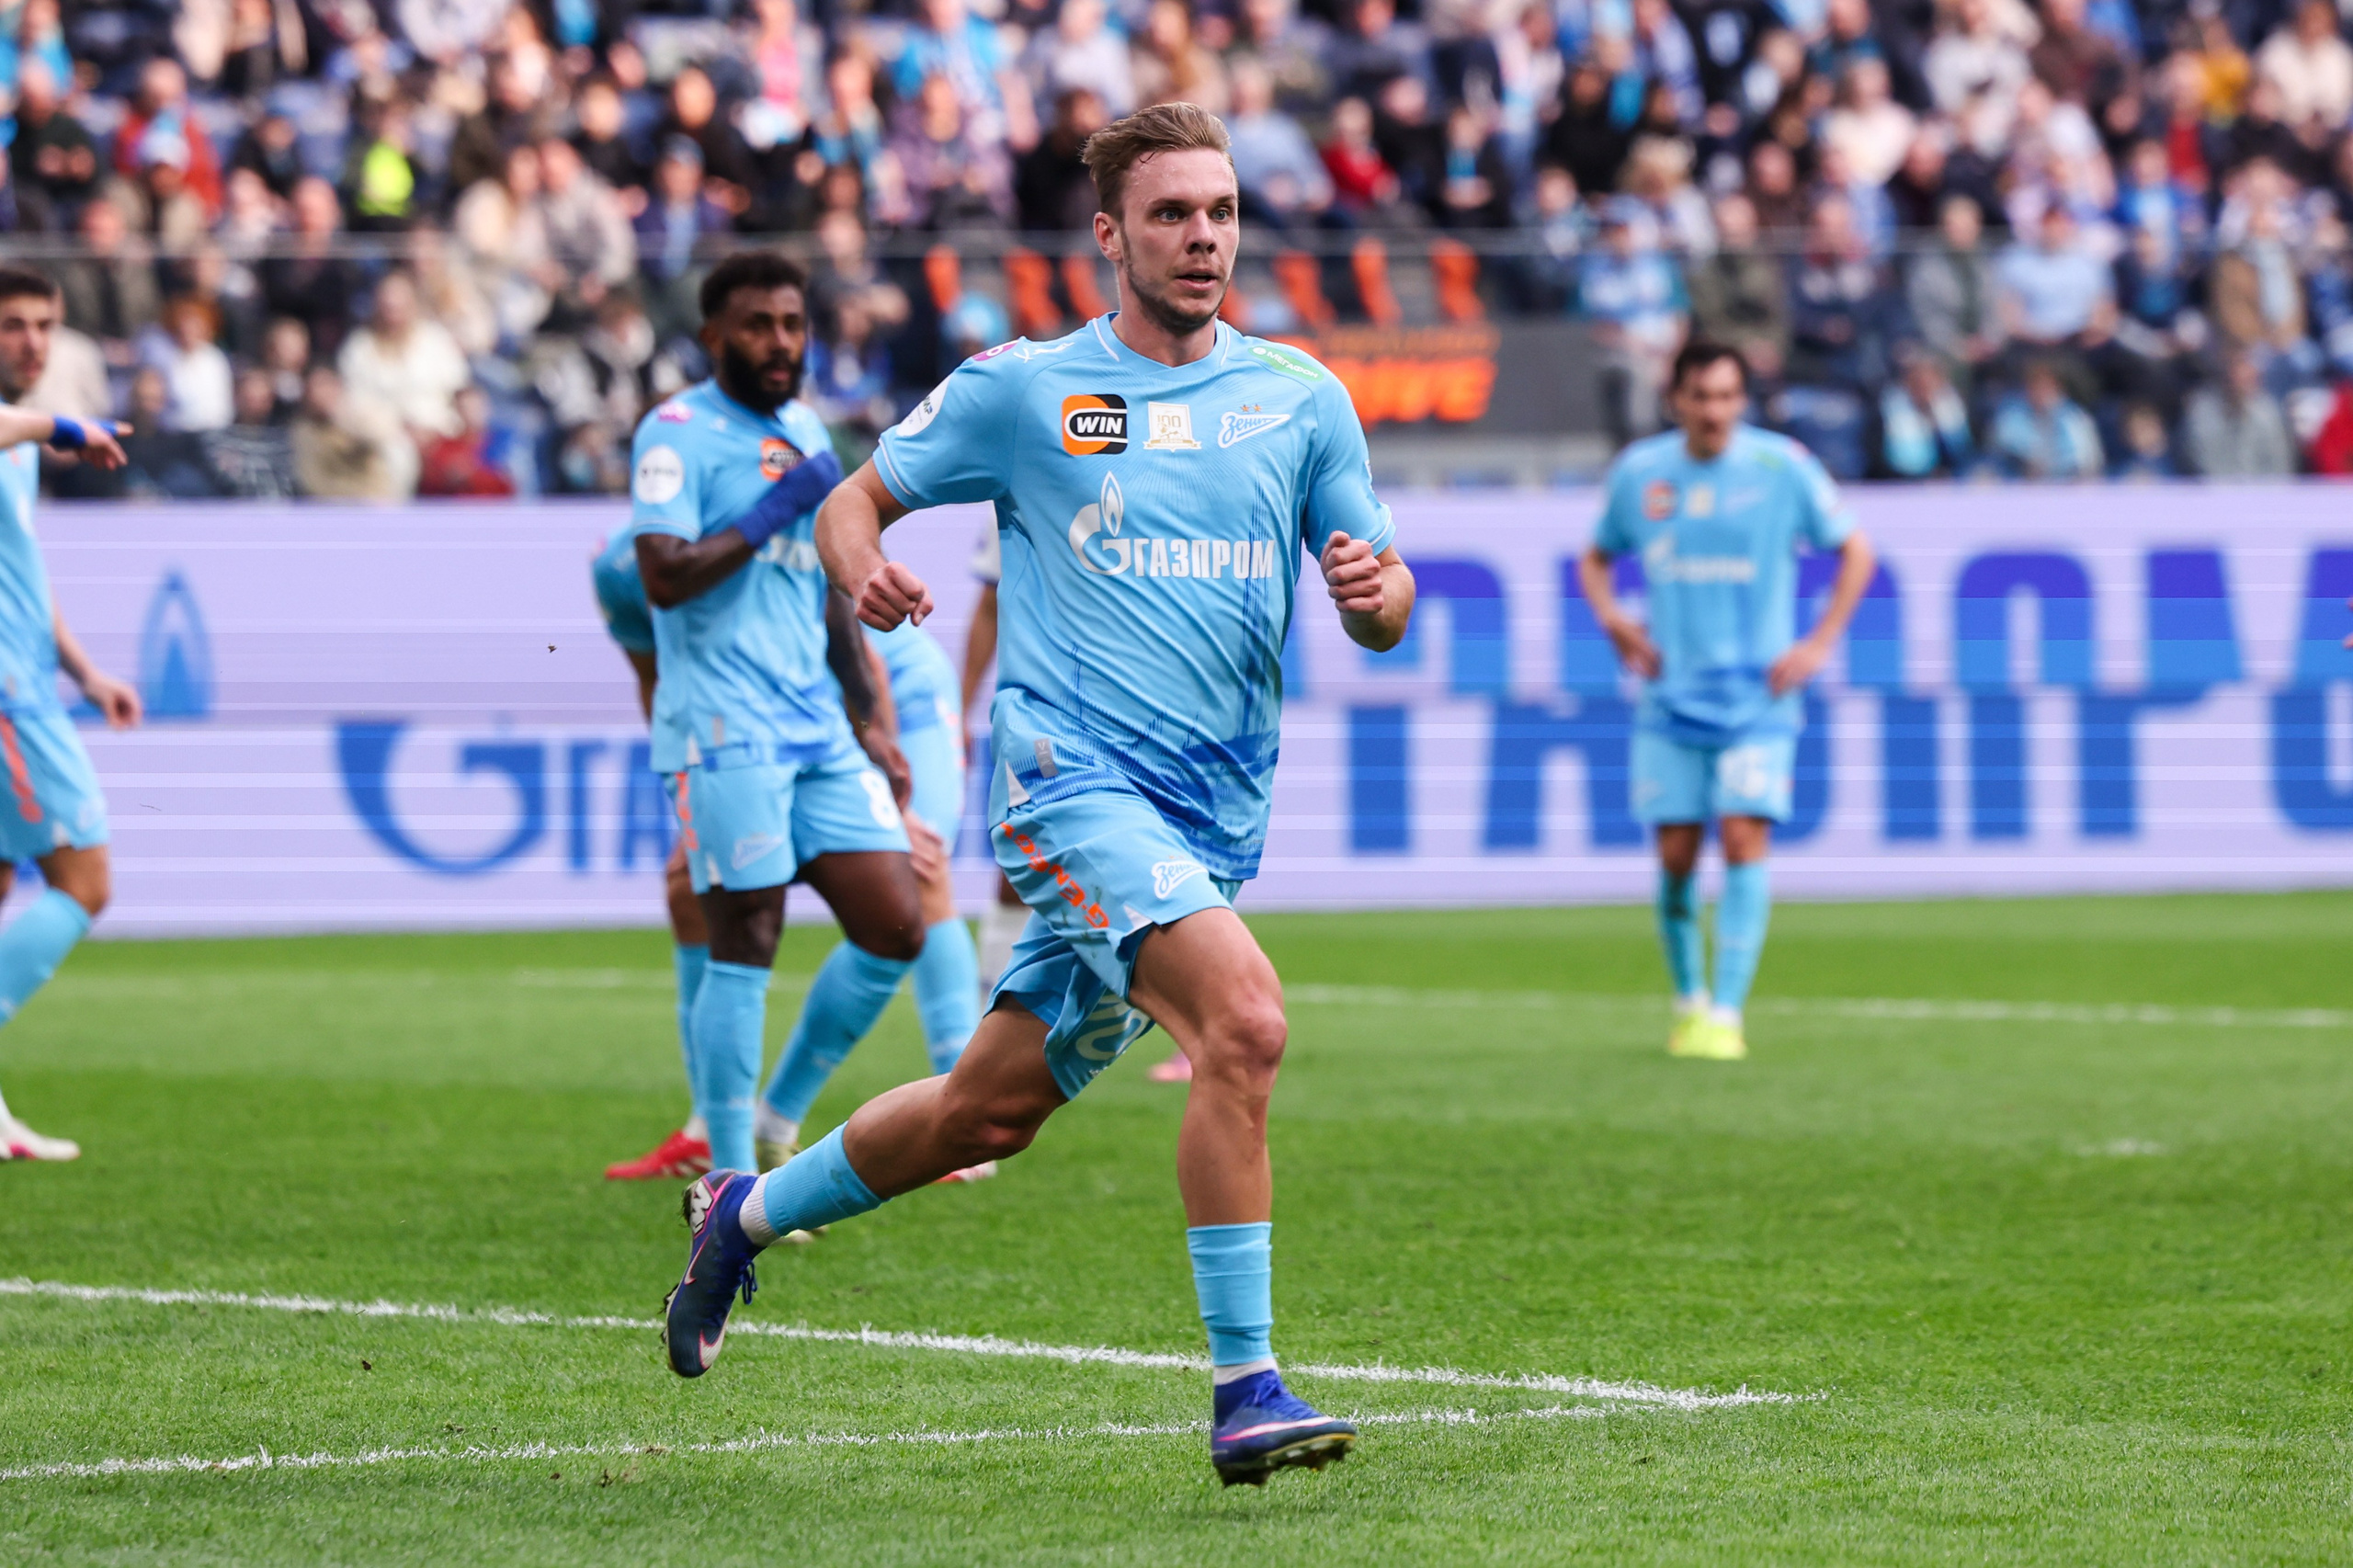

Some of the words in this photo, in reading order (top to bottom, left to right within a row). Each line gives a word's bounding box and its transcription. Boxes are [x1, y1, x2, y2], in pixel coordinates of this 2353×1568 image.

[1267, 351, 1318, 379] МЕГАФОН
[1076, 415, 1123, 435] WIN
[1156, 415, 1182, 428] 100
[1133, 538, 1276, 579] ГАЗПРОМ
